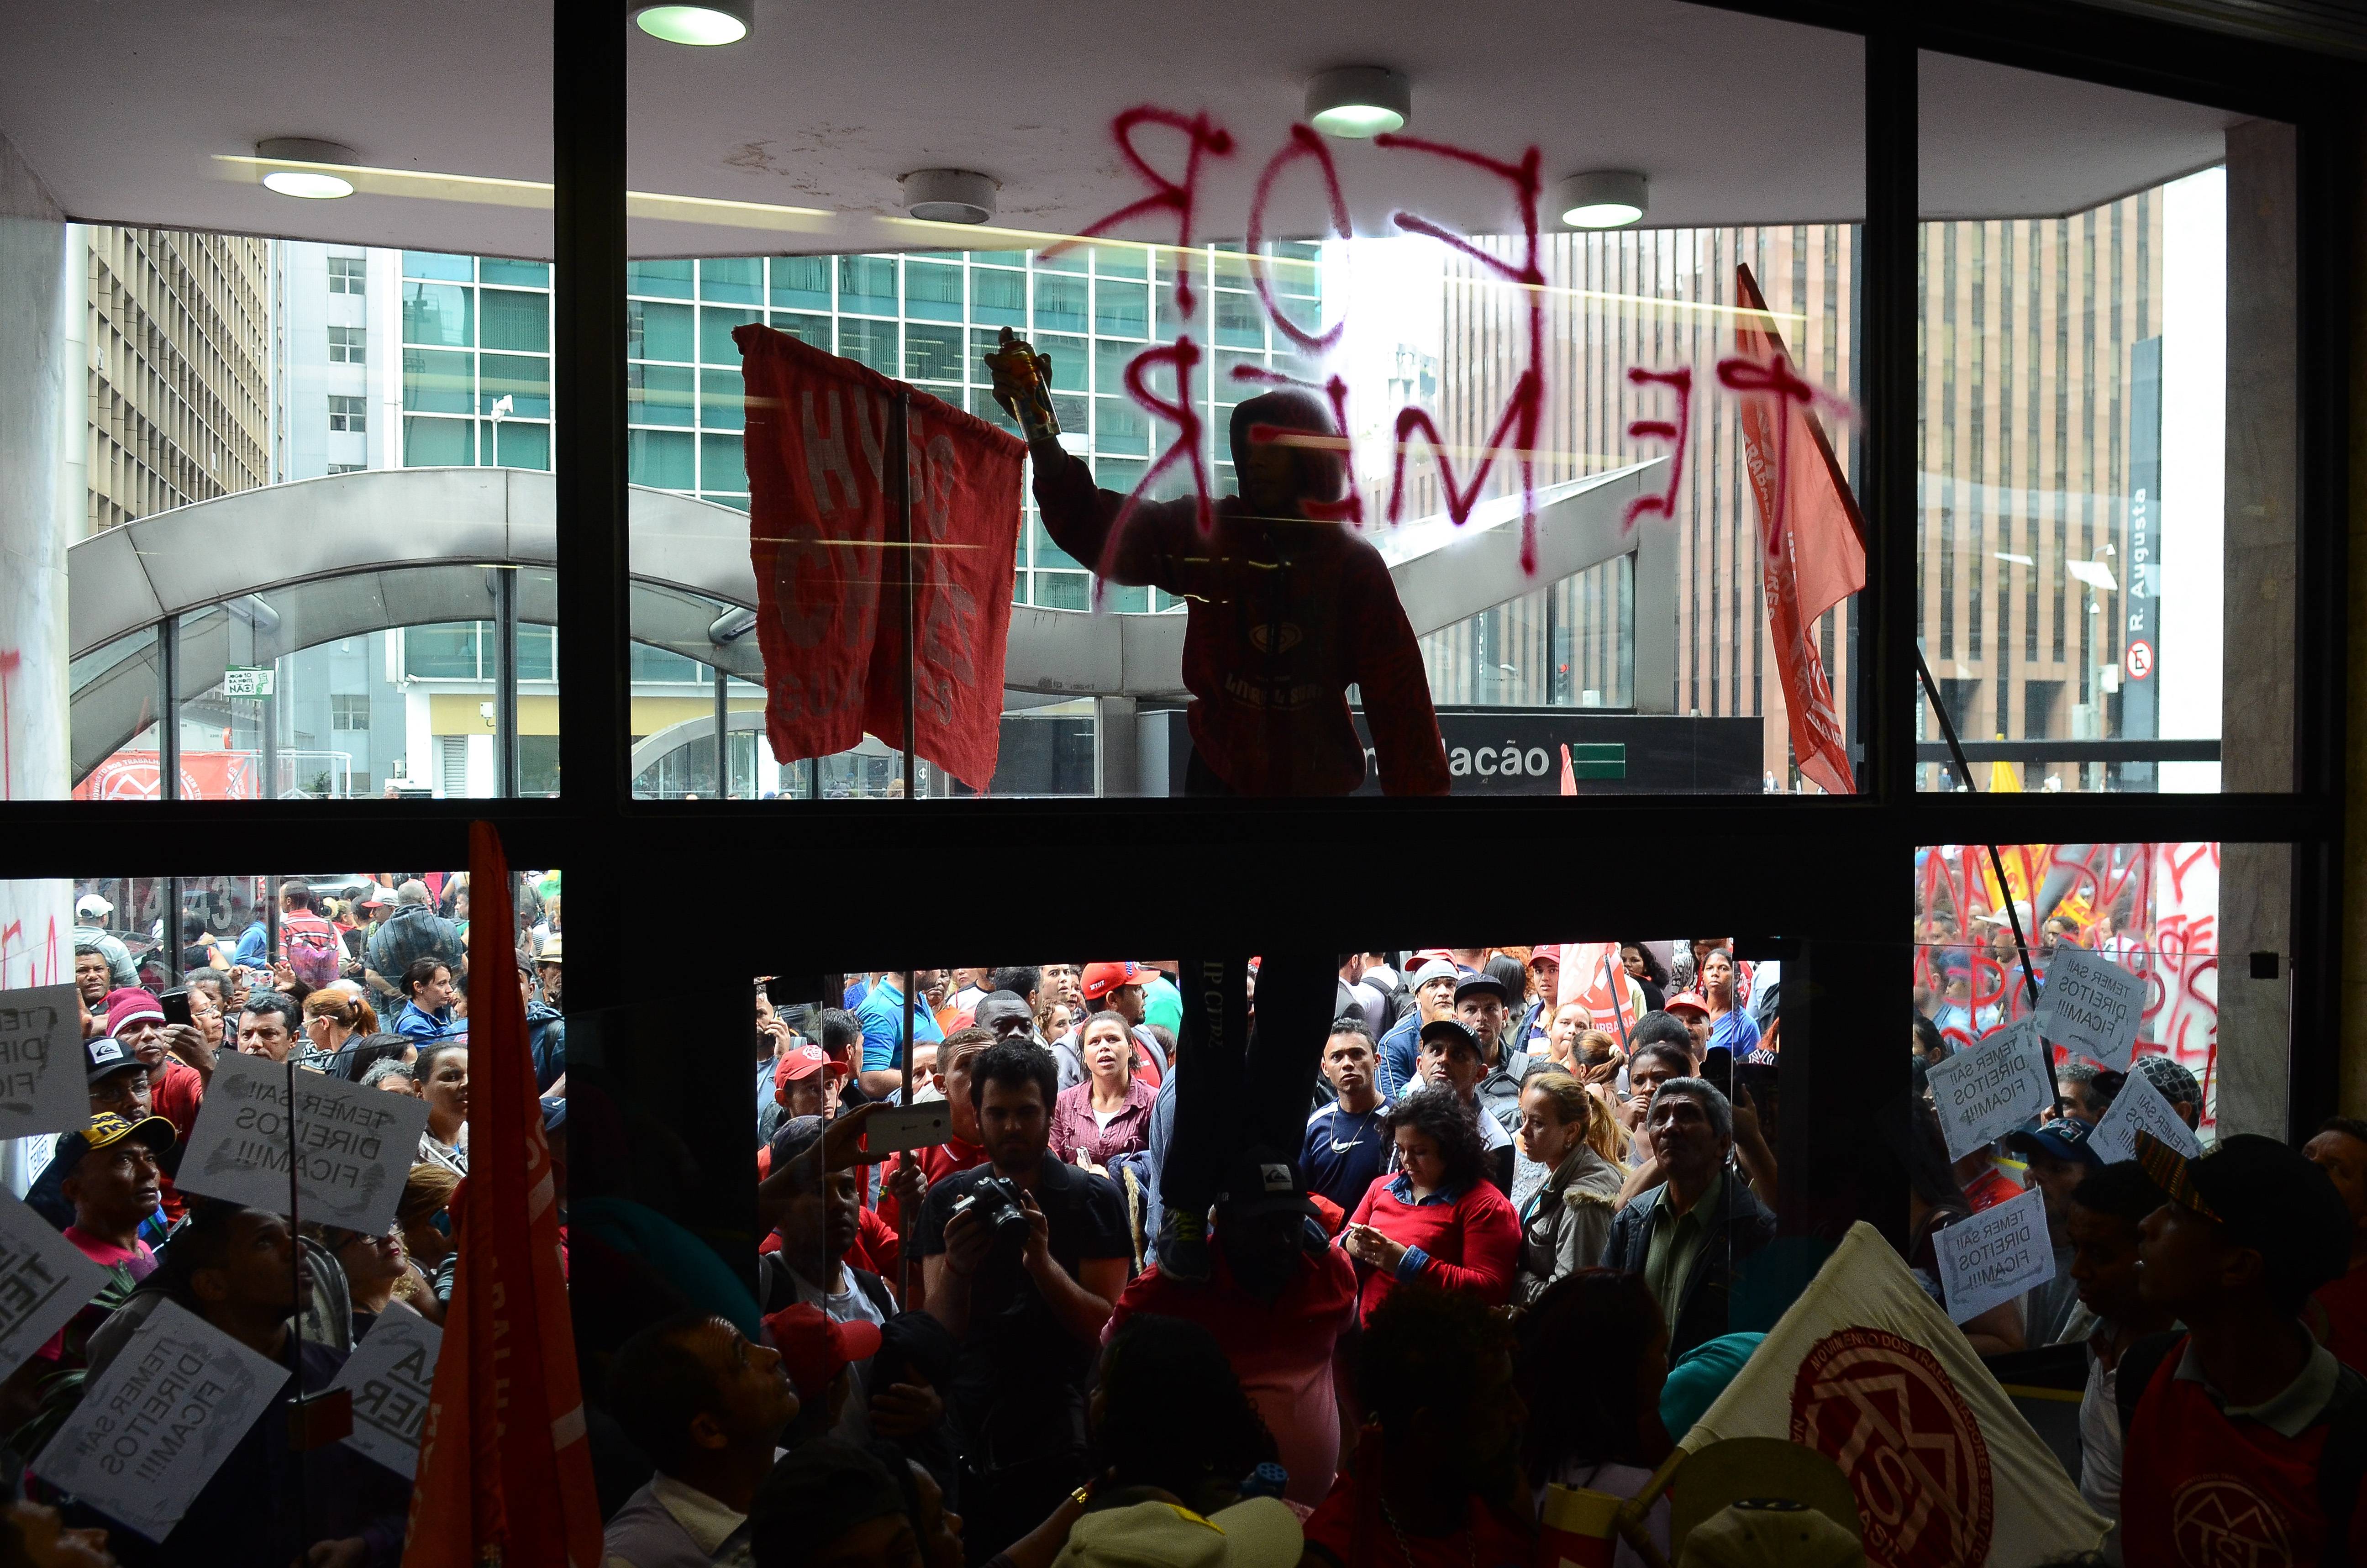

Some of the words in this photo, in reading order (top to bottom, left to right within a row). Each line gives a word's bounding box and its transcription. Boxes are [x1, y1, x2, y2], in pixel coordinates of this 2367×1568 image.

[2131, 488, 2149, 599] Augusta
[2129, 607, 2144, 632] R.
[229, 683, 254, 693] NÃO!
[106, 761, 122, 771] DOS
[185, 774, 198, 789] SEM
[1203, 960, 1224, 985] IP
[30, 1139, 48, 1171] TEMER
[1809, 1331, 1878, 1372] MOVIMENTO
[1881, 1334, 1910, 1353] DOS
